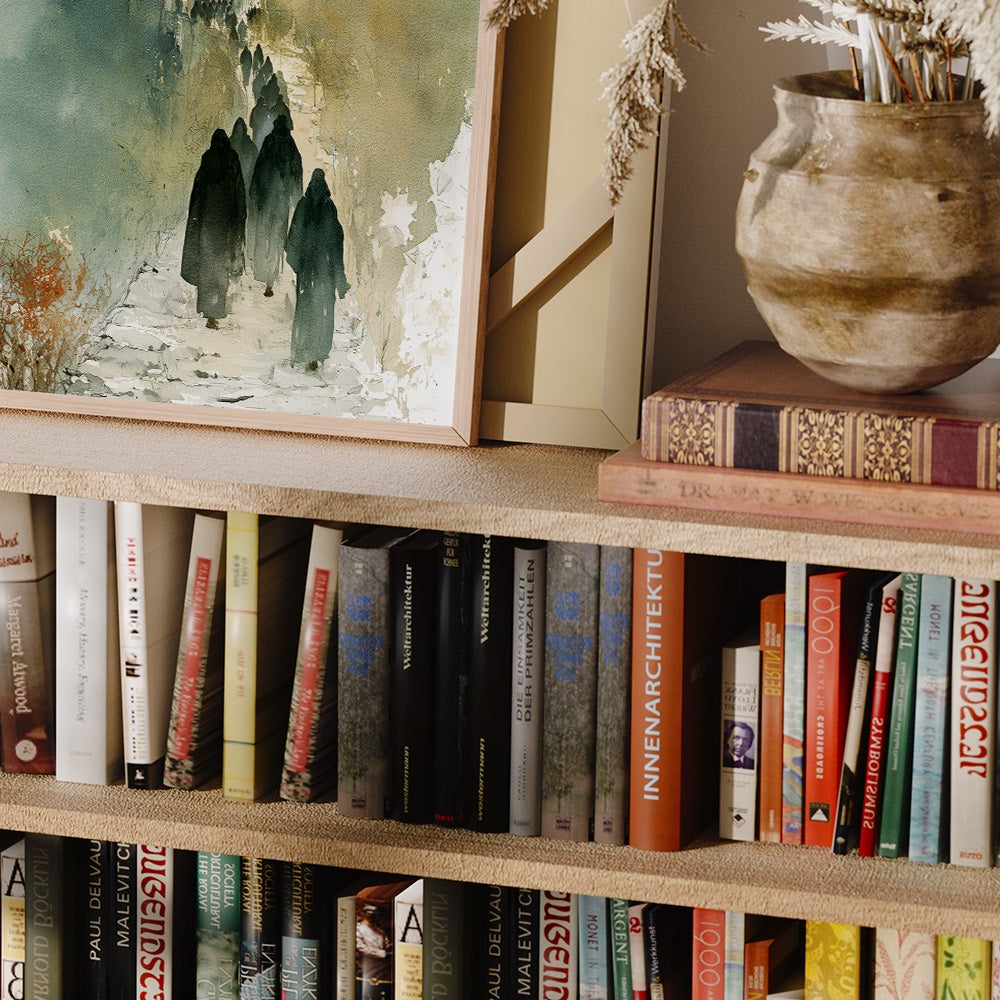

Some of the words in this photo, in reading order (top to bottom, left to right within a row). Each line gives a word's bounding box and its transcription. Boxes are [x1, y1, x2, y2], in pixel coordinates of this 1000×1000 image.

[6, 594, 26, 657] Margaret
[403, 564, 413, 671] Weltarchitektur
[516, 573, 526, 686] EINSAMKEIT
[525, 558, 536, 679] PRIMZAHLEN
[11, 660, 33, 715] Atwood
[516, 691, 524, 722] DIE
[524, 684, 533, 723] DER
[477, 737, 486, 821] westermann
[89, 916, 102, 961] PAUL
[399, 903, 424, 945] A
[587, 914, 598, 952] MONET
[648, 925, 659, 975] Werkkunst
[693, 921, 721, 987] 1900
